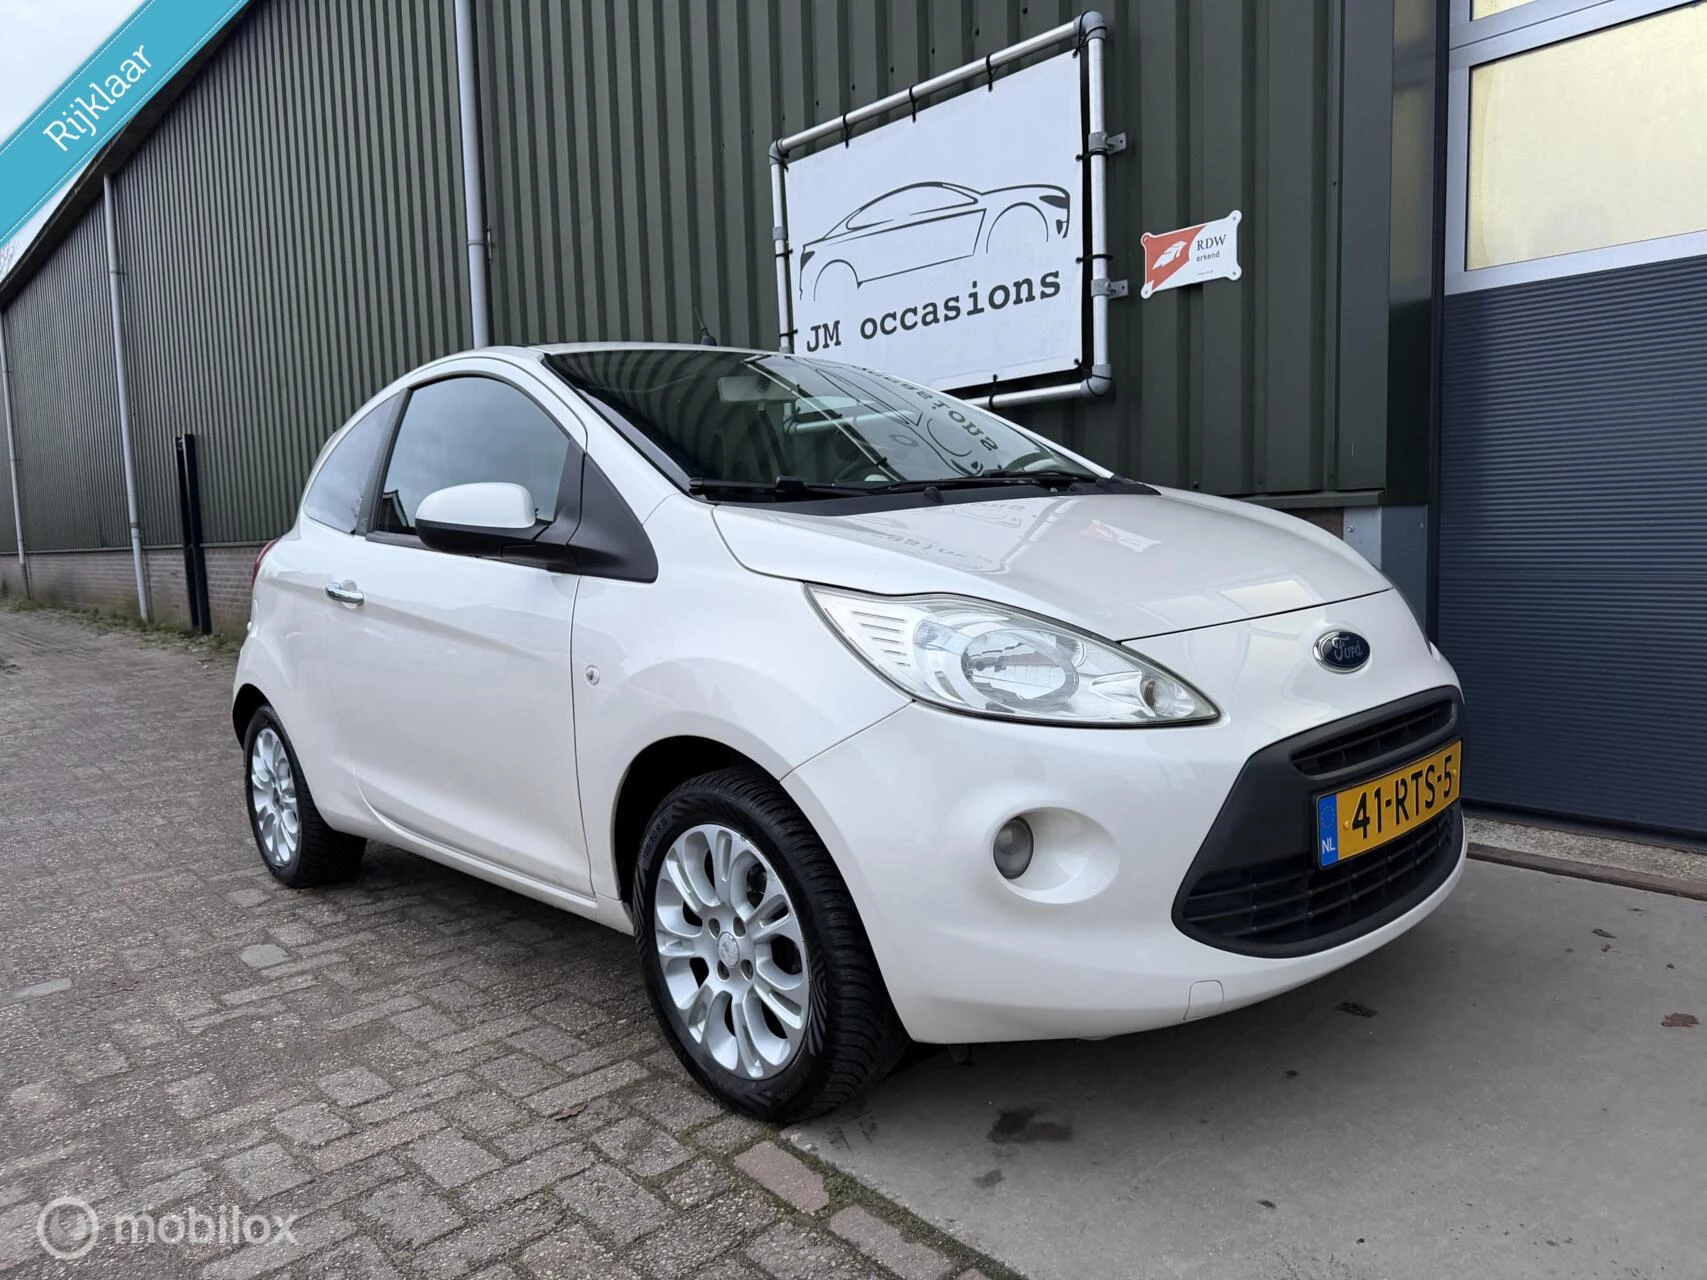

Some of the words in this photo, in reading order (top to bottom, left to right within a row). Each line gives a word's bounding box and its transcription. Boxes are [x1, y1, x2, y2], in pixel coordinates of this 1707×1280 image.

[1197, 234, 1227, 251] RDW
[1196, 251, 1220, 262] erkend
[806, 320, 842, 352] JM
[860, 270, 1061, 340] occasions
[1331, 636, 1363, 661] Ford
[1351, 754, 1453, 840] 41-RTS-5
[1321, 837, 1336, 854] NL
